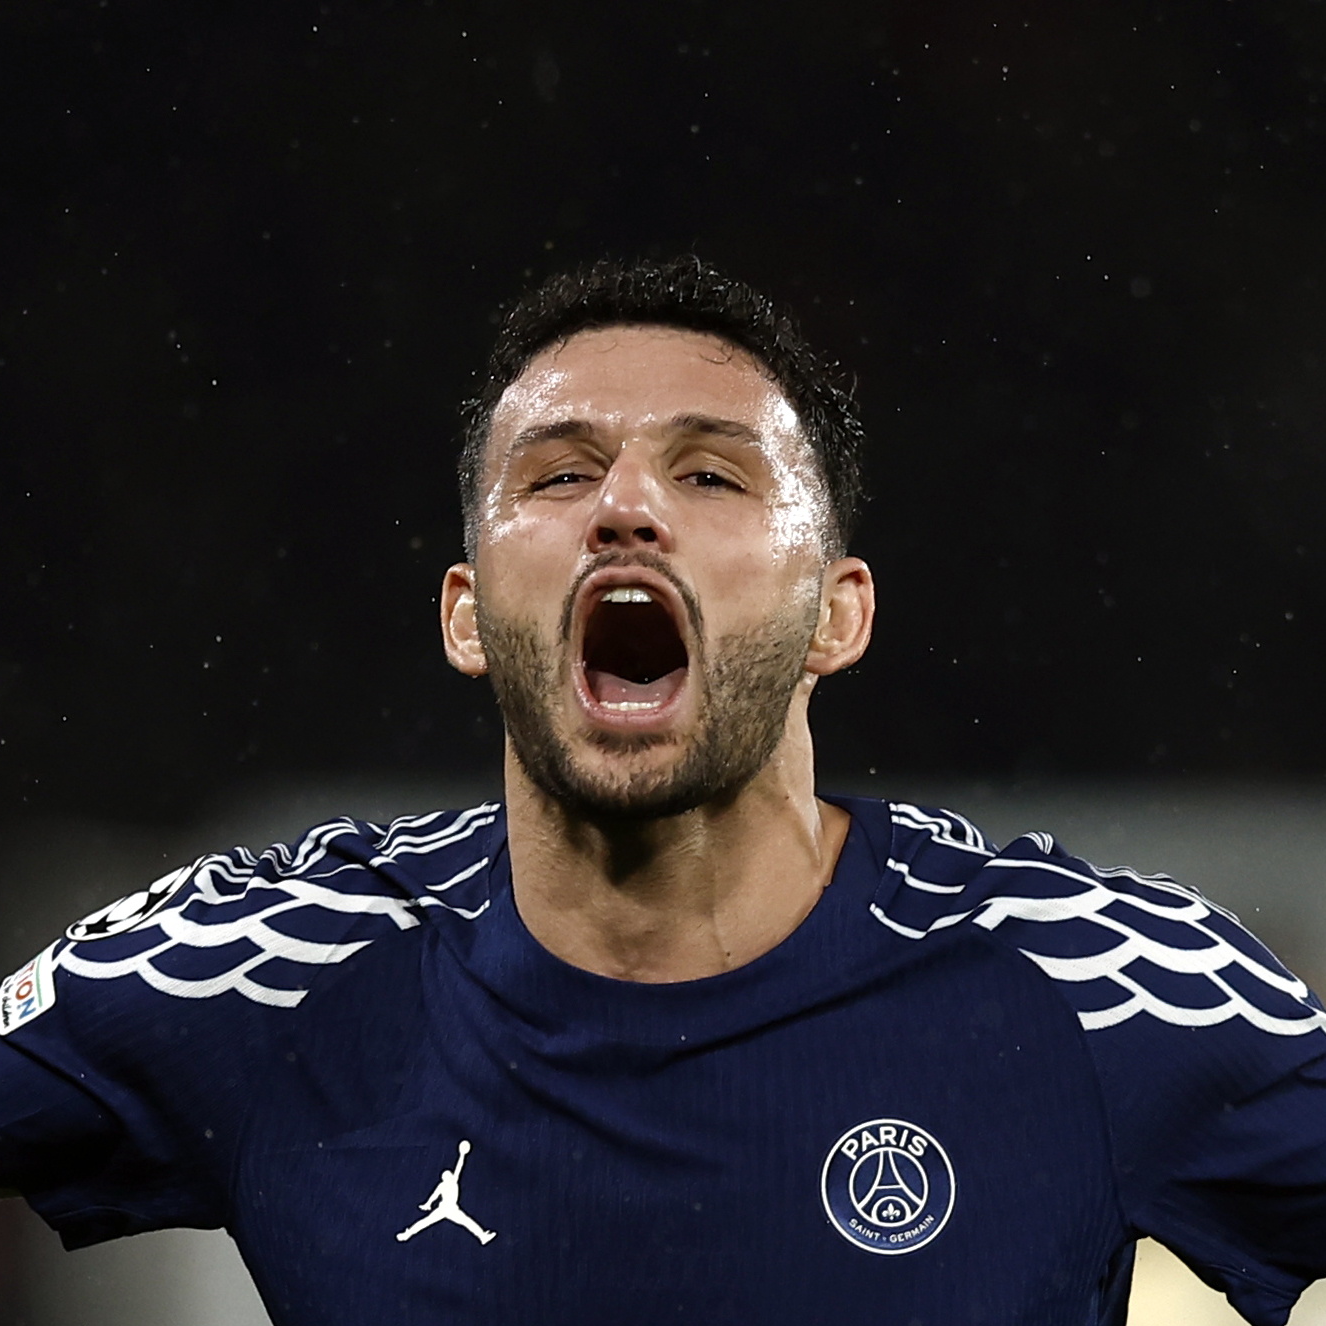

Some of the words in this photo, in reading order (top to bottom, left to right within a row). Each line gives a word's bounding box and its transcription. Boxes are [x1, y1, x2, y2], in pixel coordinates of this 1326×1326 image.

[841, 1126, 928, 1161] PARIS
[849, 1218, 881, 1241] SAINT
[889, 1215, 934, 1243] GERMAIN
